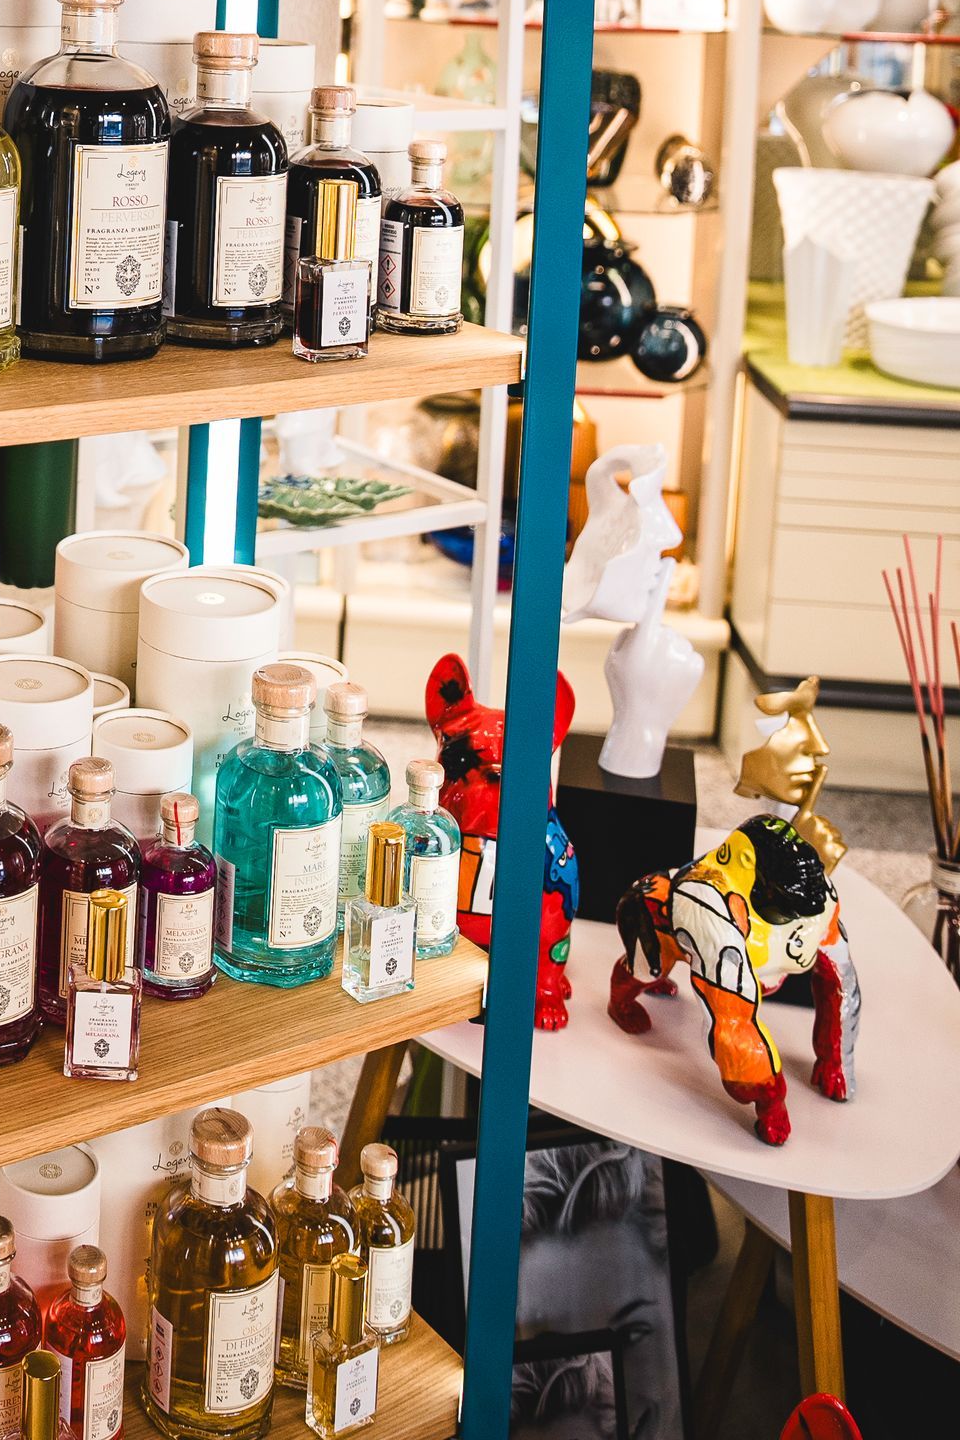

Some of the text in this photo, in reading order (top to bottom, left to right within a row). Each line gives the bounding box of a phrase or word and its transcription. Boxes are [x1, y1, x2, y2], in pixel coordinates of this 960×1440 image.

[116, 164, 146, 182] Logevy
[112, 194, 149, 207] ROSSO
[101, 210, 154, 223] PERVERSO
[246, 216, 274, 226] ROSSO
[303, 860, 327, 873] MARE
[12, 933, 22, 942] DI
[166, 927, 206, 936] MELAGRANA
[1, 952, 31, 968] D'AMBIENTE
[242, 1322, 261, 1336] ORO
[226, 1327, 270, 1351] DI FIRENZE
[218, 1350, 250, 1358] FRAGRANZA
